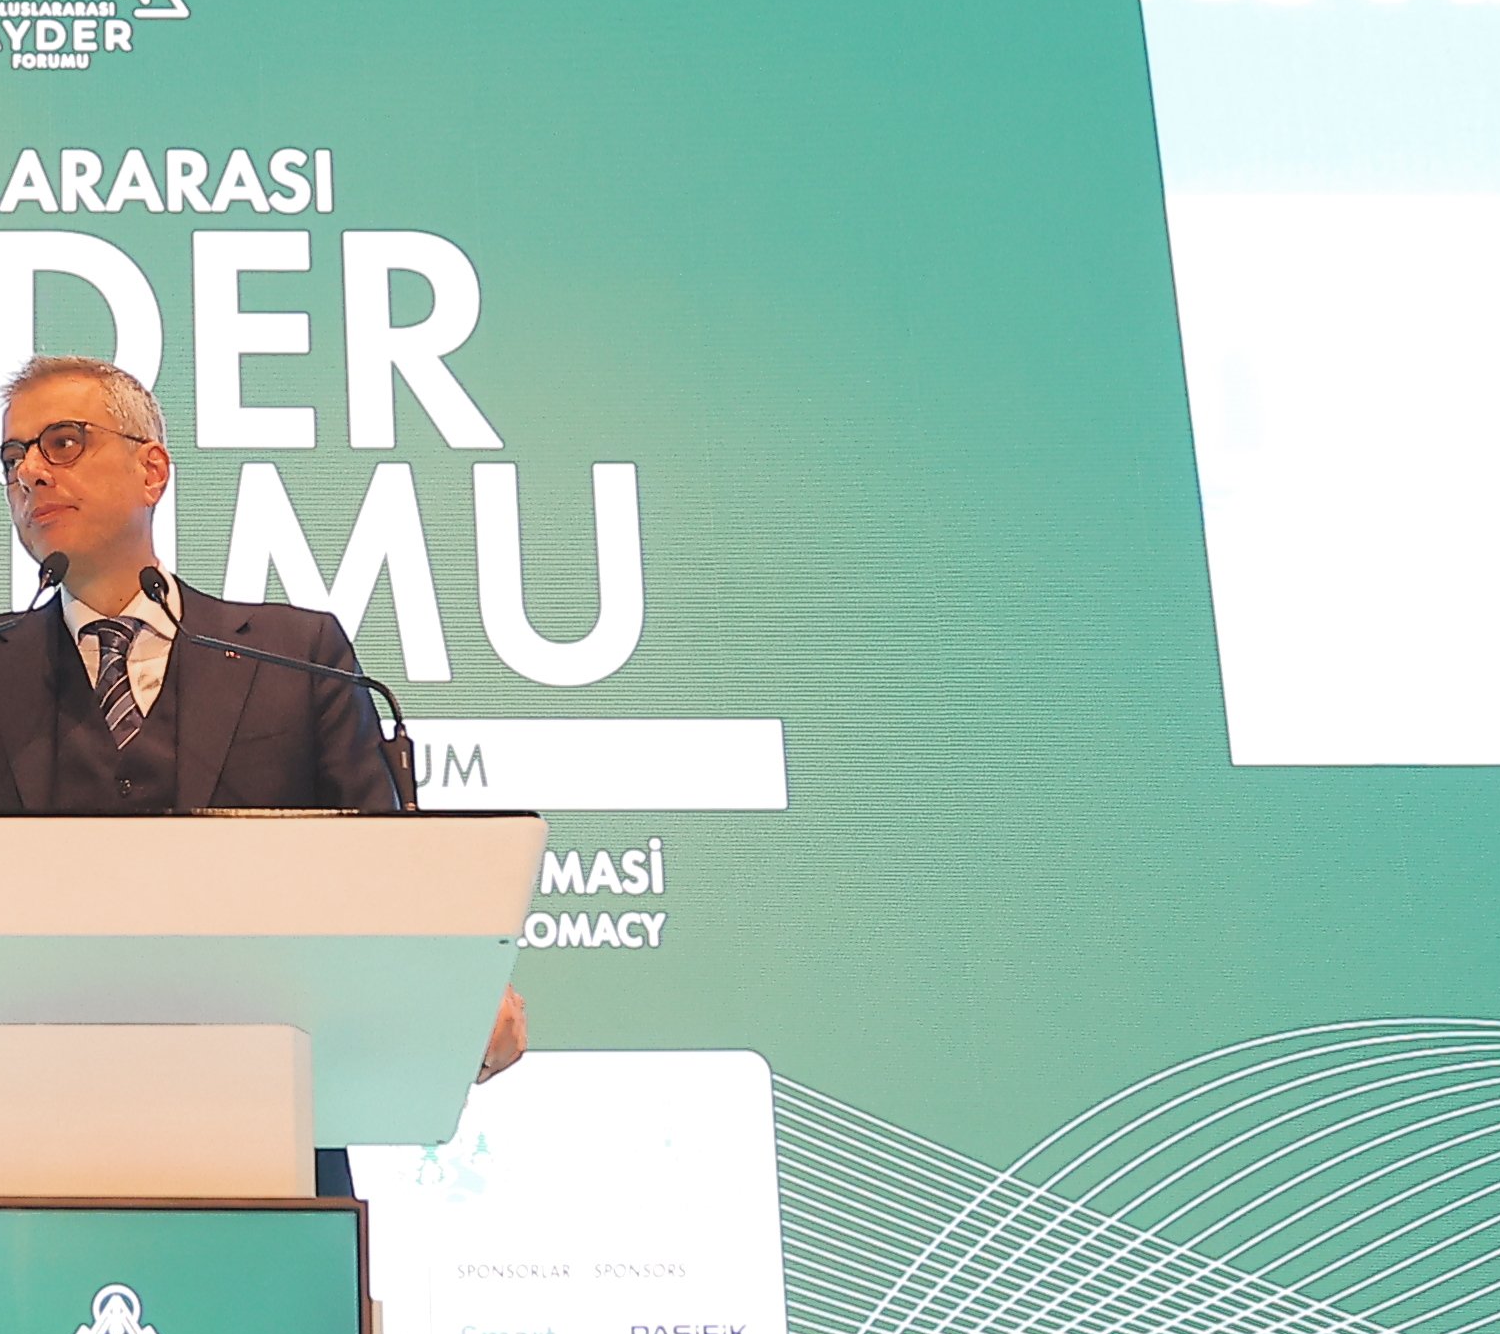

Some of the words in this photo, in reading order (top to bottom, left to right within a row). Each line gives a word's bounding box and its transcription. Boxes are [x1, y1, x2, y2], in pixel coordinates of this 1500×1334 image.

[12, 52, 90, 69] FORUMU
[516, 911, 666, 949] OMACY
[457, 1264, 570, 1279] SPONSORLAR
[593, 1263, 686, 1279] SPONSORS
